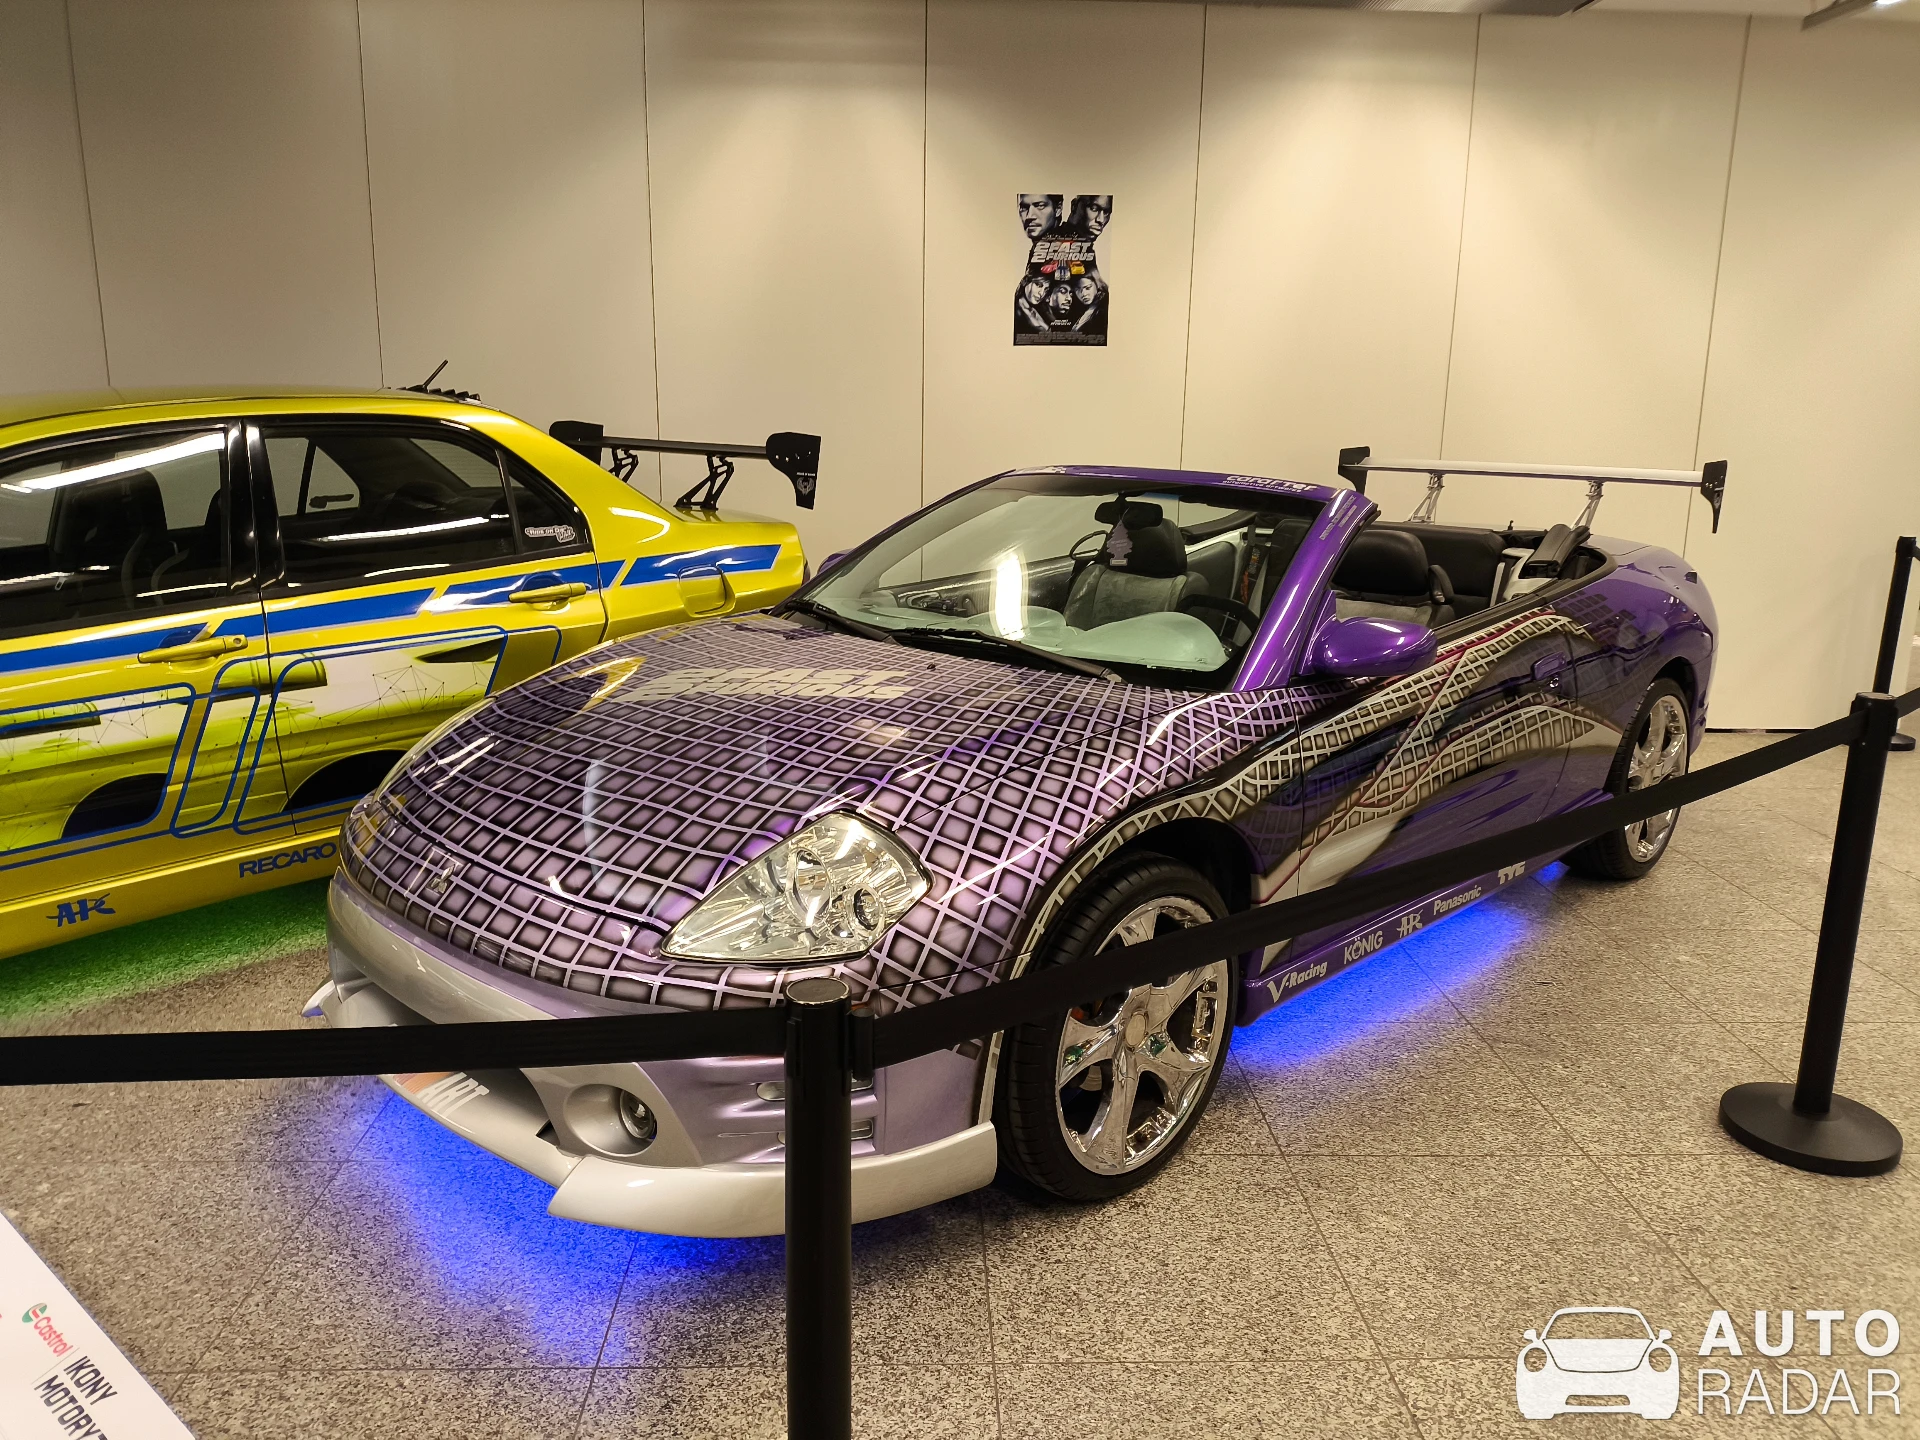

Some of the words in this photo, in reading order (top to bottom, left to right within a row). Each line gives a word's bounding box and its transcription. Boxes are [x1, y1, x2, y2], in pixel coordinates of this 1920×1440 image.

[239, 842, 337, 878] RECARO
[1433, 885, 1482, 916] Panasonic
[1344, 931, 1383, 964] KÖNIG
[1267, 962, 1328, 1004] V-Racing
[33, 1316, 73, 1357] Castrol
[63, 1355, 118, 1405] IKONY
[34, 1375, 109, 1440] MOTORY
